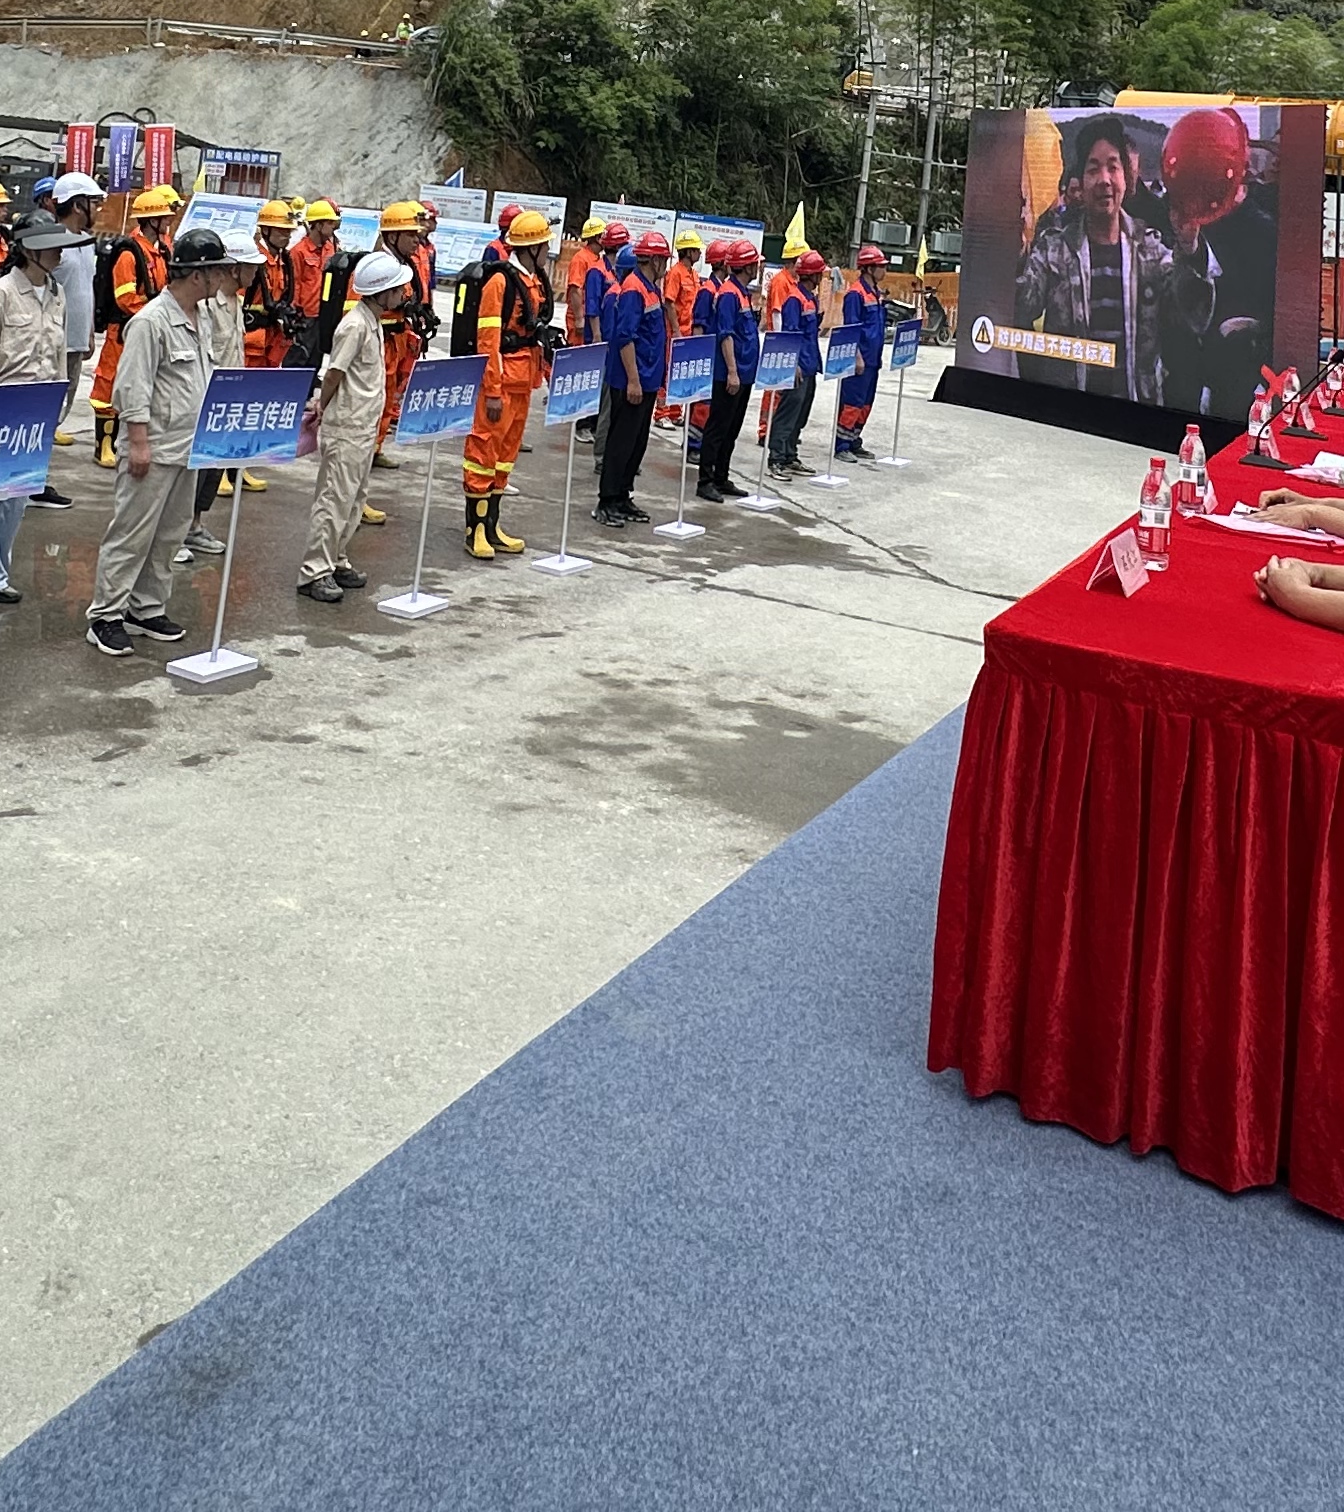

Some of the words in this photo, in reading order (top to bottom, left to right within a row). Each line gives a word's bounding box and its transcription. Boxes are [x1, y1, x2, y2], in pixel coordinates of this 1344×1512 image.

[998, 328, 1112, 364] 防护用品不符合标准
[553, 369, 600, 396] 应急救援组
[672, 358, 712, 381] 设施保障组
[408, 384, 475, 413] 技术专家组
[205, 401, 298, 432] 记录宣传组
